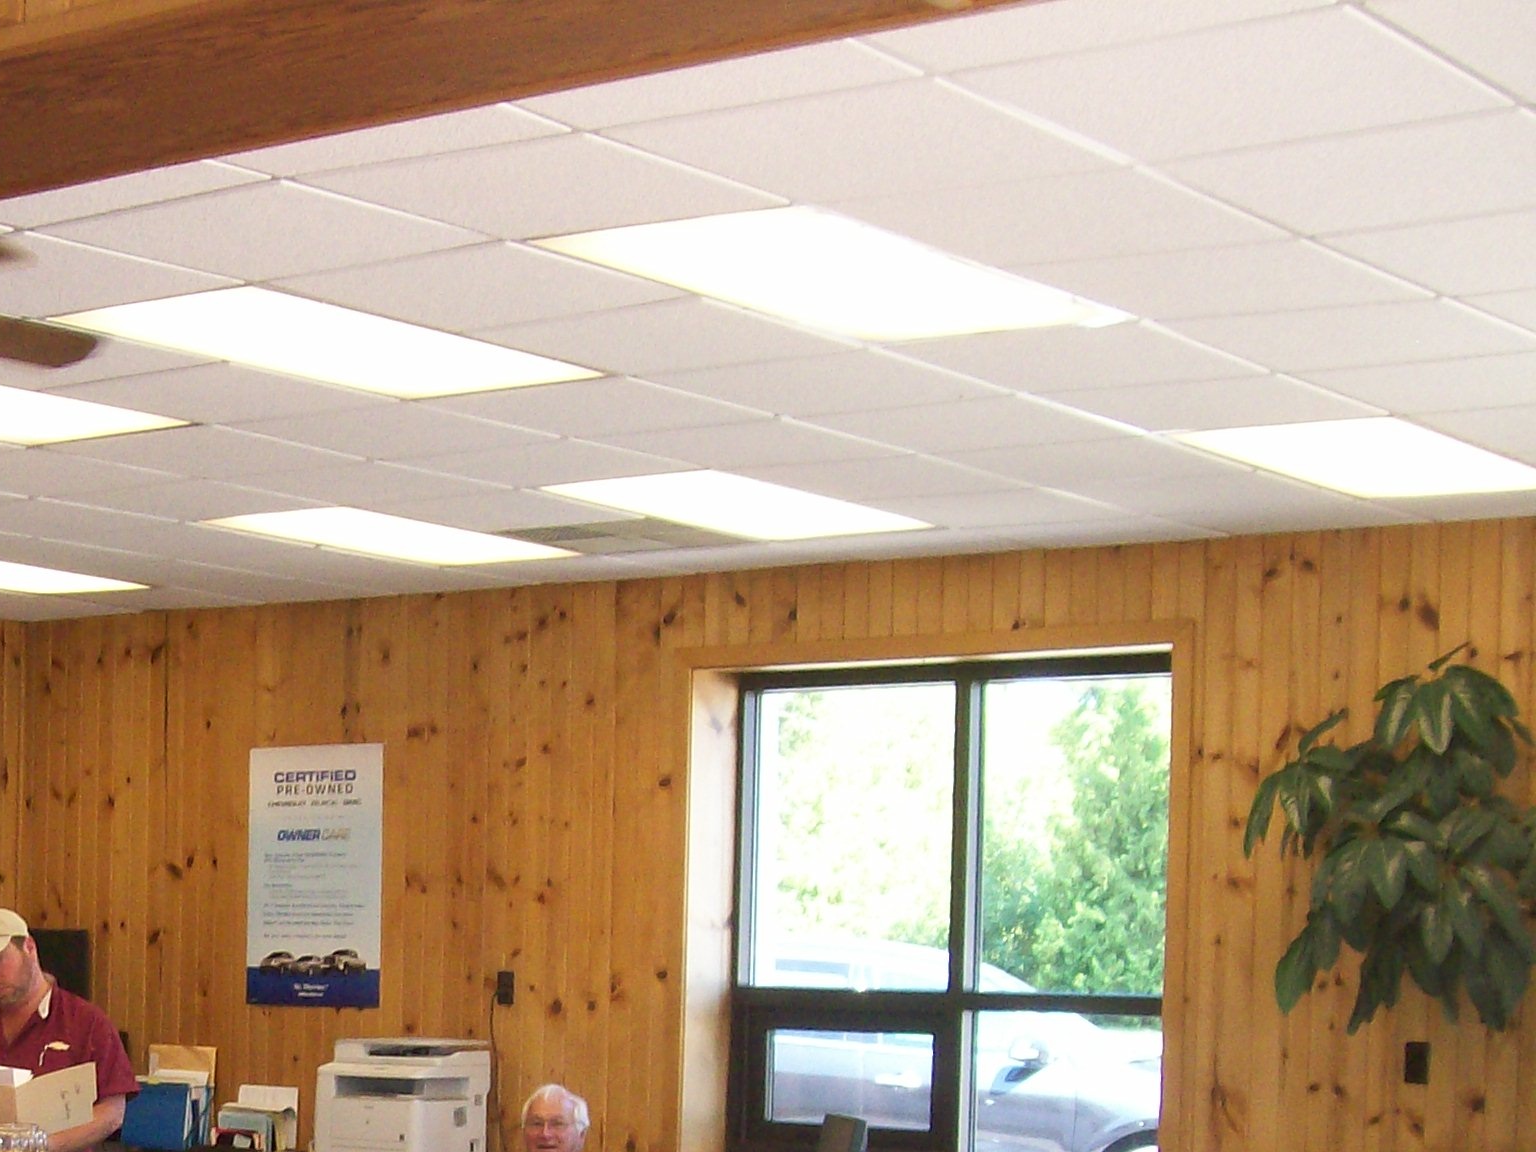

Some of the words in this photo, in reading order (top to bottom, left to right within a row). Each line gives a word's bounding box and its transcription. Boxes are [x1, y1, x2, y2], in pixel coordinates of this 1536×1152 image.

[274, 769, 356, 783] CERTIFIED
[276, 783, 354, 796] PRE-OWNED
[277, 829, 321, 841] OWNER
